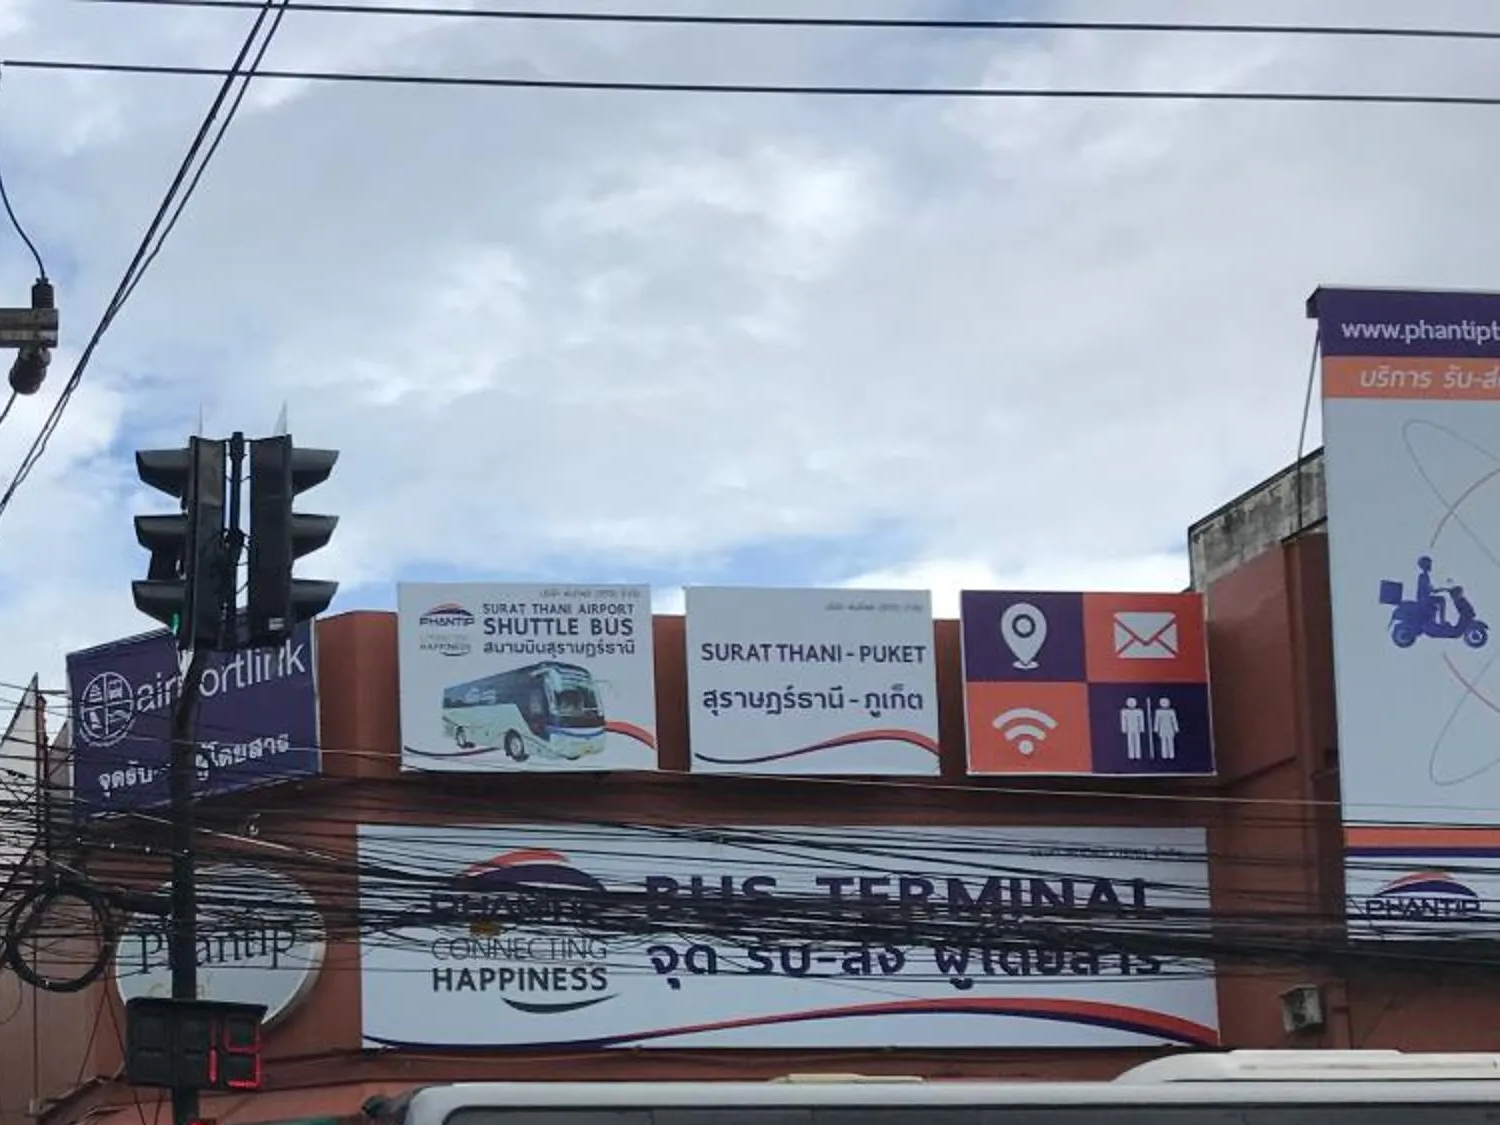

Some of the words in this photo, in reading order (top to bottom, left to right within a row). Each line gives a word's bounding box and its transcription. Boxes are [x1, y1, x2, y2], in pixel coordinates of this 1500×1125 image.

[1360, 364, 1433, 389] บริการ
[482, 603, 525, 615] SURAT
[532, 603, 572, 615] THANI
[578, 603, 634, 615] AIRPORT
[483, 617, 579, 636] SHUTTLE
[591, 617, 634, 636] BUS
[701, 643, 772, 662] SURAT
[776, 644, 842, 663] THANI
[860, 645, 927, 664] PUKET
[136, 637, 307, 714] airortlink
[703, 684, 844, 718] สุราษฎร์ธานี
[864, 683, 923, 718] ภูเก็ต
[139, 920, 296, 975] Pantip
[431, 936, 608, 961] CONNECTING
[432, 967, 608, 992] HAPPINESS
